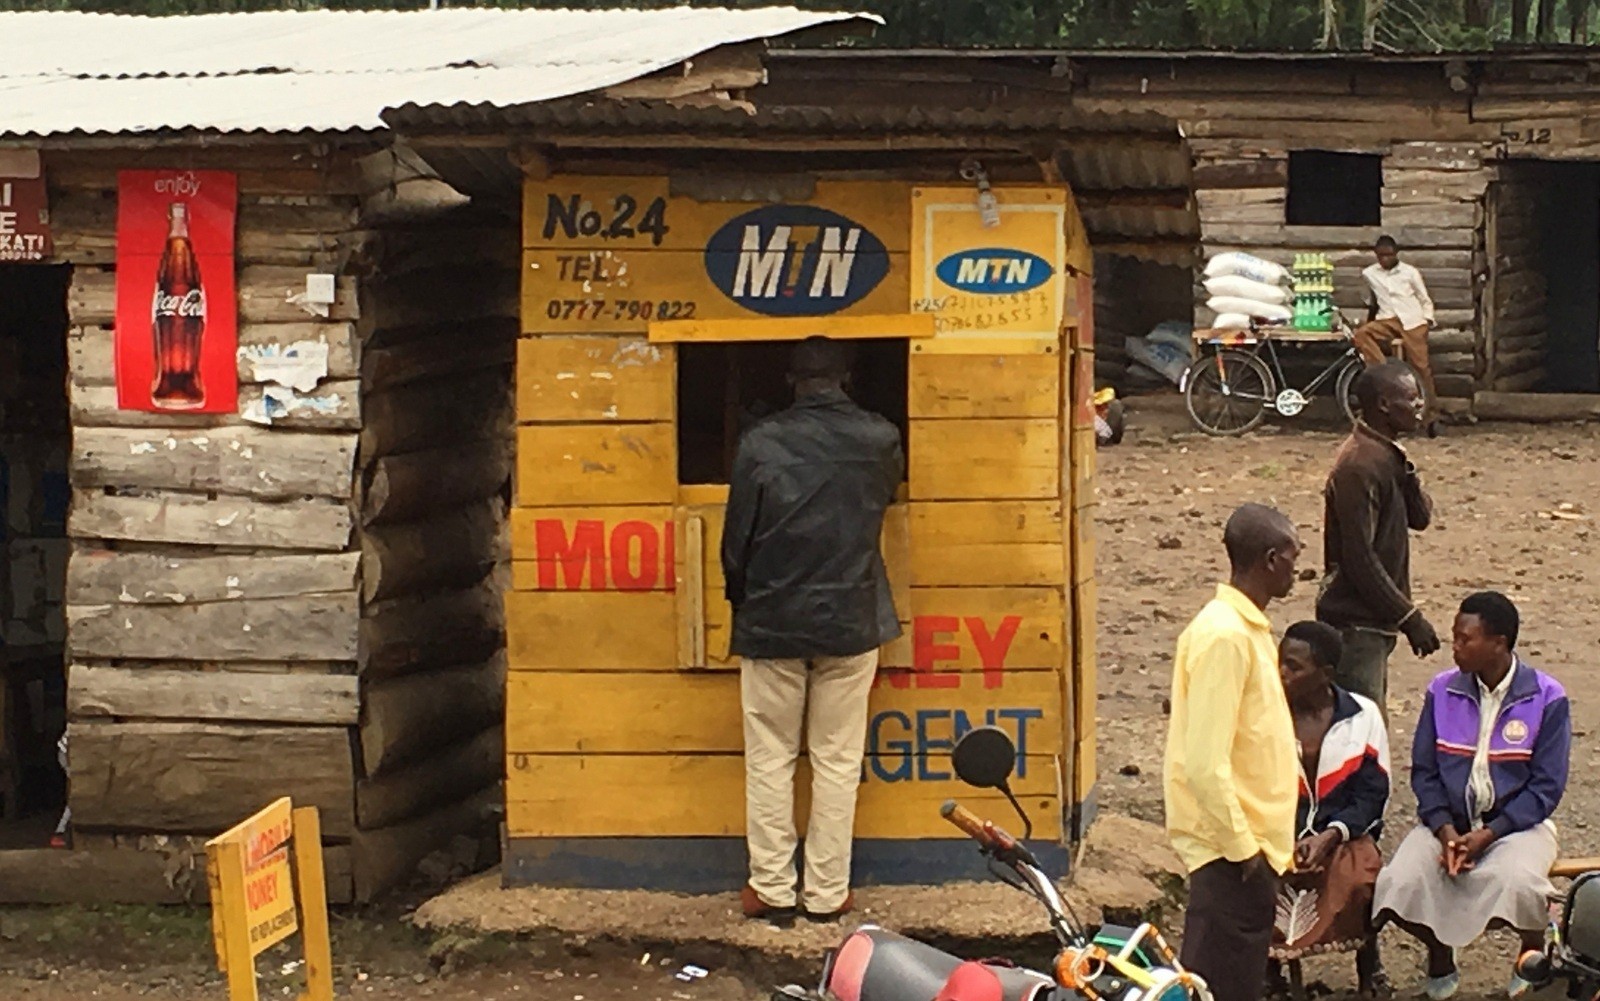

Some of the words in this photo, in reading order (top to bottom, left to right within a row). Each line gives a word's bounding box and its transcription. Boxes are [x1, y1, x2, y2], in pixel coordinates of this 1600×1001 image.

[154, 171, 202, 197] enjoy
[733, 225, 861, 298] MTN
[956, 258, 1032, 284] MTN
[534, 518, 675, 593] MO
[871, 615, 1023, 690] EY
[860, 709, 1043, 783] GET
